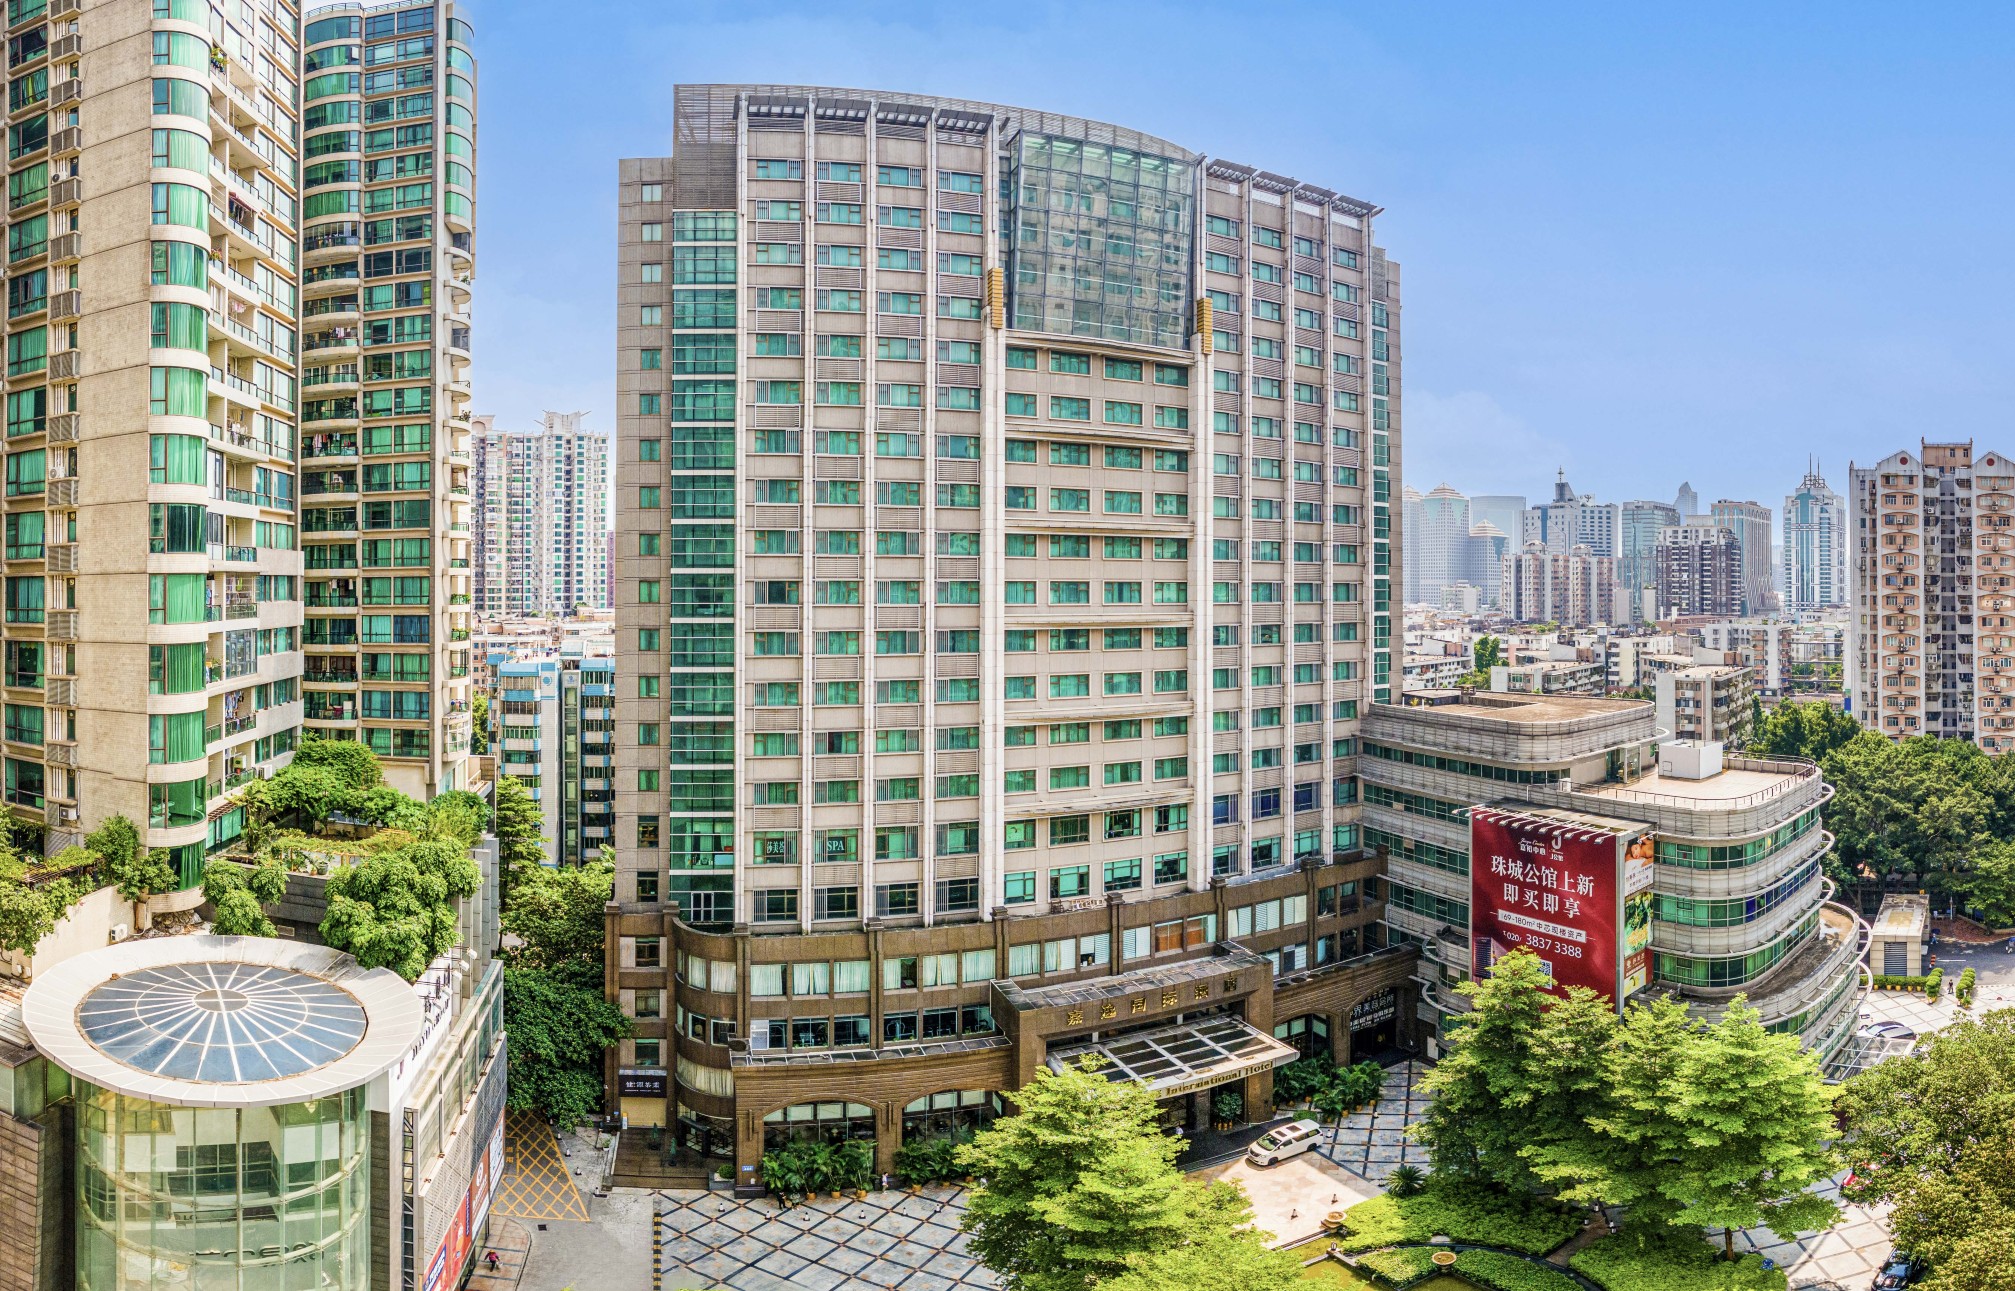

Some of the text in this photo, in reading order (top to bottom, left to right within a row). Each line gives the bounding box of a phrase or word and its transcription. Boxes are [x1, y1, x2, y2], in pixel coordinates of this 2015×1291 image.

[826, 840, 845, 851] SPA
[1490, 855, 1595, 898] 珠城公馆上新
[1503, 882, 1581, 919] 即买即享
[1525, 933, 1552, 951] 3837
[1554, 941, 1582, 959] 3388
[1166, 1069, 1241, 1096] International
[1245, 1060, 1273, 1076] Hotel
